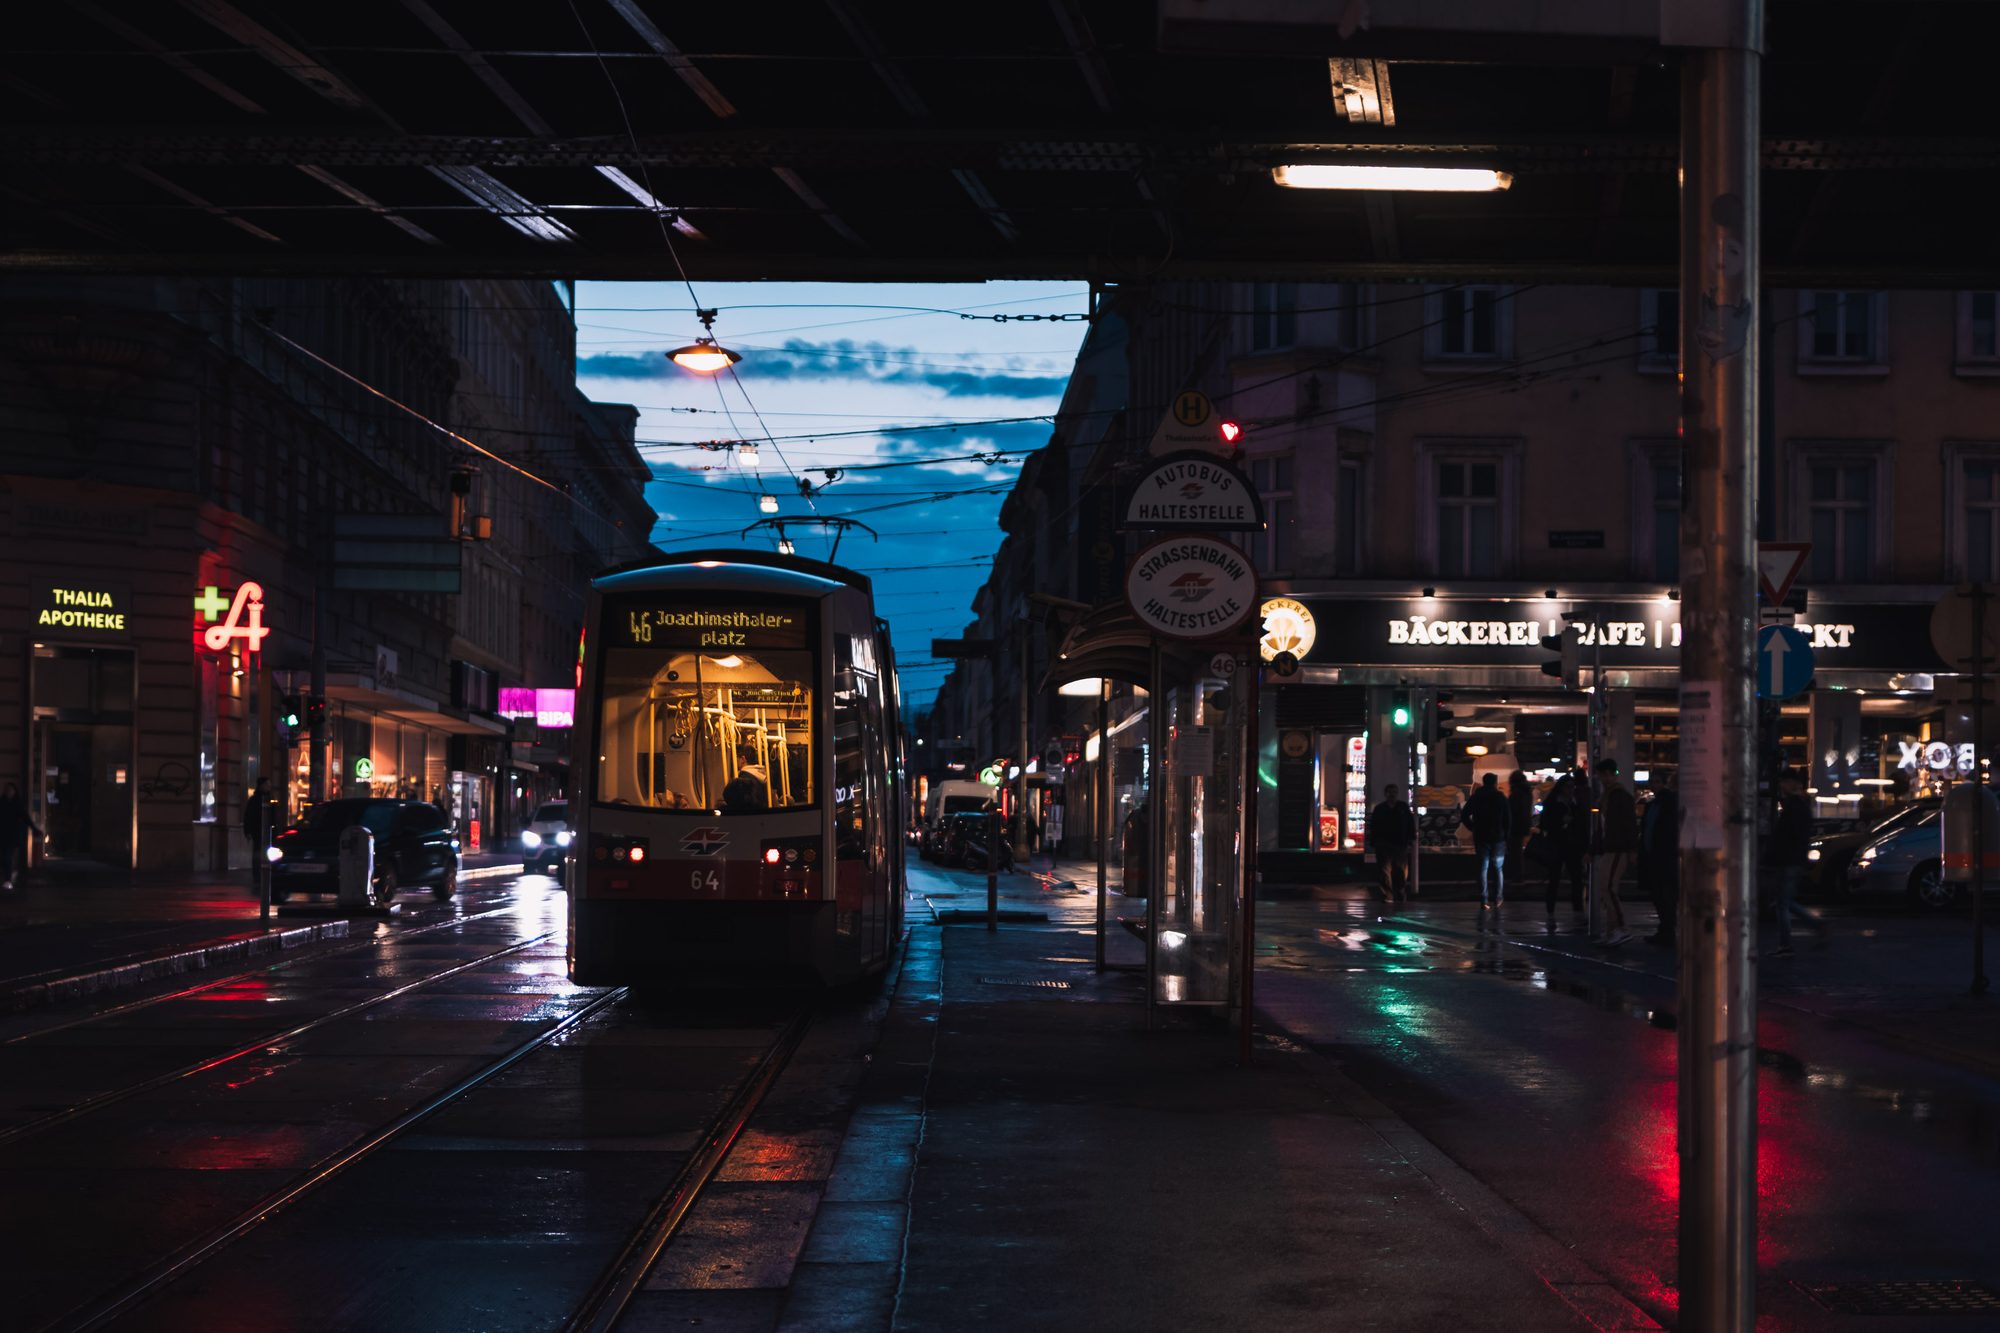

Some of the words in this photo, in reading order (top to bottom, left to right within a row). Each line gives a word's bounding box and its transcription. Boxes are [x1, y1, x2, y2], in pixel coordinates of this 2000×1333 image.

[1155, 463, 1232, 490] AUTOBUS
[1139, 504, 1245, 520] HALTESTELLE
[1139, 545, 1245, 581] STRASSENBAHN
[52, 588, 113, 608] THALIA
[38, 609, 125, 630] APOTHEKE
[1143, 598, 1241, 629] HALTESTELLE
[630, 611, 652, 643] 46
[656, 610, 793, 627] Joachimsthaler-
[1388, 616, 1540, 645] BÄCKEREI
[701, 630, 746, 646] platz
[1212, 659, 1234, 673] 46
[537, 711, 574, 726] BIPA
[690, 869, 719, 891] 64
